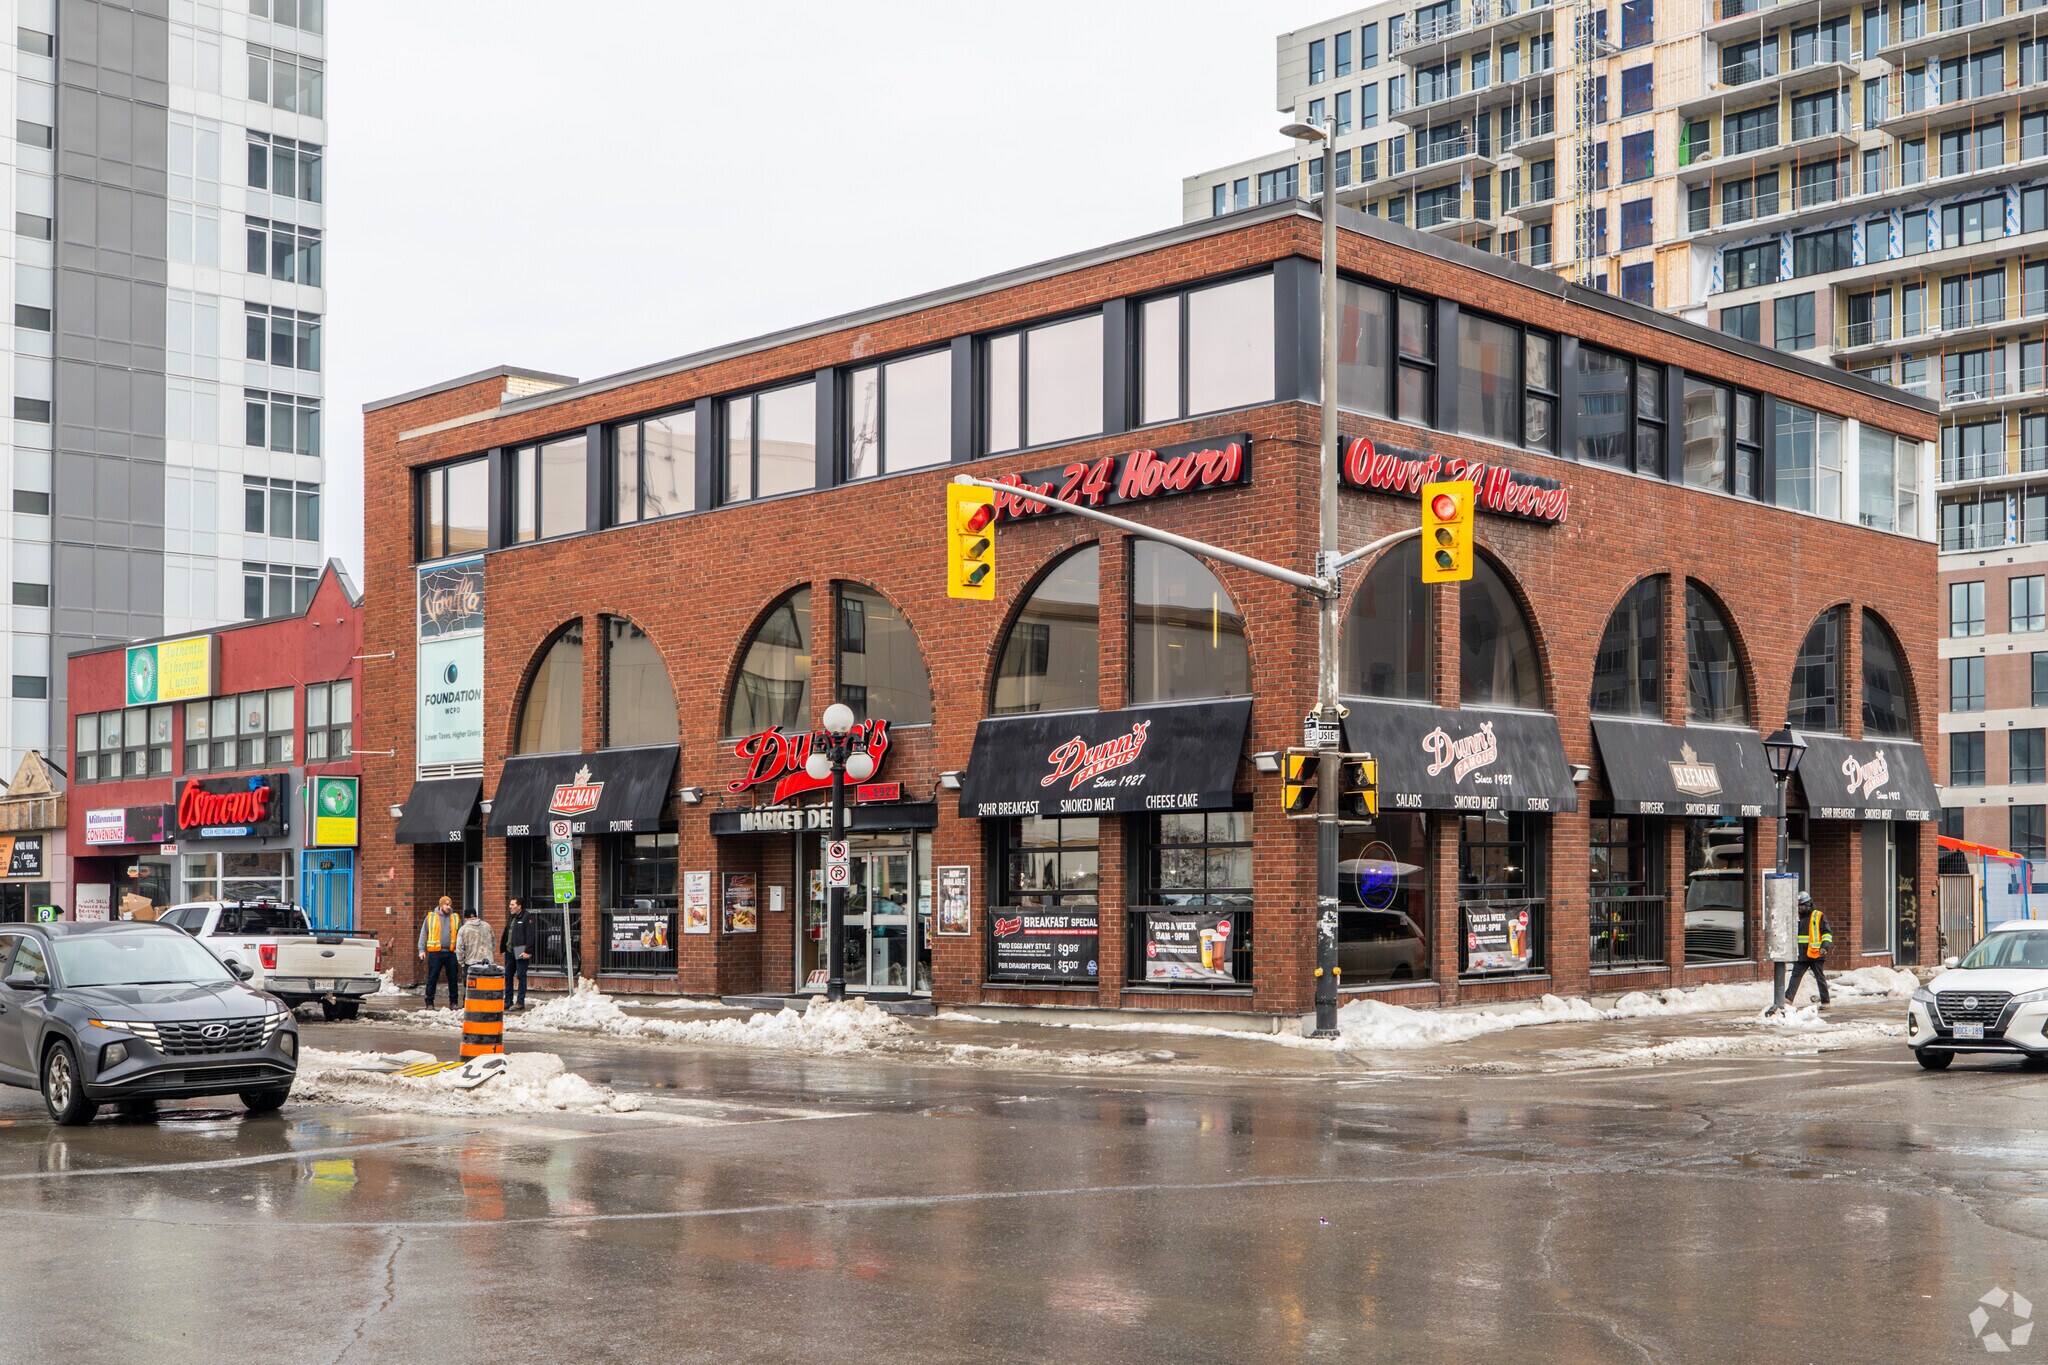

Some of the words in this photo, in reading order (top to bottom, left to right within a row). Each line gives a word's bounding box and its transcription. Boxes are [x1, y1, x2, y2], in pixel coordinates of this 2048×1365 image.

[982, 474, 1053, 521] pen
[1058, 456, 1114, 506] 24
[1118, 443, 1242, 499] Hours
[1345, 437, 1442, 494] Ouvert
[1445, 458, 1485, 505] 24
[1482, 466, 1569, 523] Heures
[425, 576, 480, 621] Vanilla
[424, 688, 482, 706] FOUNDATION
[425, 731, 438, 741] Lower
[452, 728, 467, 740] Higher
[467, 726, 480, 739] Giving
[1041, 719, 1151, 787] Dunn's
[1422, 721, 1496, 777] Dunn's
[1077, 752, 1136, 783] FAMOUS
[1458, 751, 1496, 775] FAMOUS
[1093, 776, 1116, 788] Since
[1119, 774, 1145, 786] 1927
[1494, 773, 1512, 785] 1927
[1673, 767, 1717, 788] SLEEMAN
[553, 787, 599, 807] SLEEMAN
[873, 786, 897, 798] 1927
[1060, 799, 1092, 812] SMOKED
[1094, 798, 1115, 811] MEAT
[1146, 795, 1176, 809] CHEESE
[1177, 794, 1198, 807] CAKE
[1396, 793, 1422, 807] SALADS
[1454, 795, 1480, 809] SMOKED
[1482, 796, 1498, 810] MEAT
[1527, 798, 1549, 810] STEAKS
[978, 803, 997, 816] 24HR
[998, 801, 1039, 815] BREAKFAST
[1640, 801, 1664, 814] BURGERS
[1685, 803, 1706, 815] SMOKED
[1707, 804, 1720, 815] MEAT
[1741, 804, 1762, 816] POUTINE
[1821, 807, 1832, 818] 24HR
[1833, 807, 1856, 819] BREAKFAST
[1865, 808, 1879, 819] SMOKED
[1880, 809, 1892, 819] MEAT
[89, 813, 122, 824] Millennium
[740, 810, 805, 831] MARKET
[808, 808, 852, 829] DEI
[507, 824, 530, 836] BURGERS
[572, 822, 586, 832] MEAT
[609, 820, 633, 832] POUTINE
[87, 828, 123, 841] CONVENIENCE
[449, 831, 461, 841] 353
[943, 877, 966, 886] AVAILABLE
[1024, 916, 1069, 927] BREAKFAST
[1071, 918, 1098, 927] SPECIAL
[1491, 913, 1506, 922] WEEK
[1149, 922, 1154, 930] 7
[1154, 922, 1170, 930] DAYS
[1170, 922, 1176, 930] A
[1176, 922, 1197, 930] WEEK
[1156, 932, 1171, 940] 9AM
[1031, 962, 1052, 970] SPECIAL
[1972, 1026, 1983, 1035] 189
